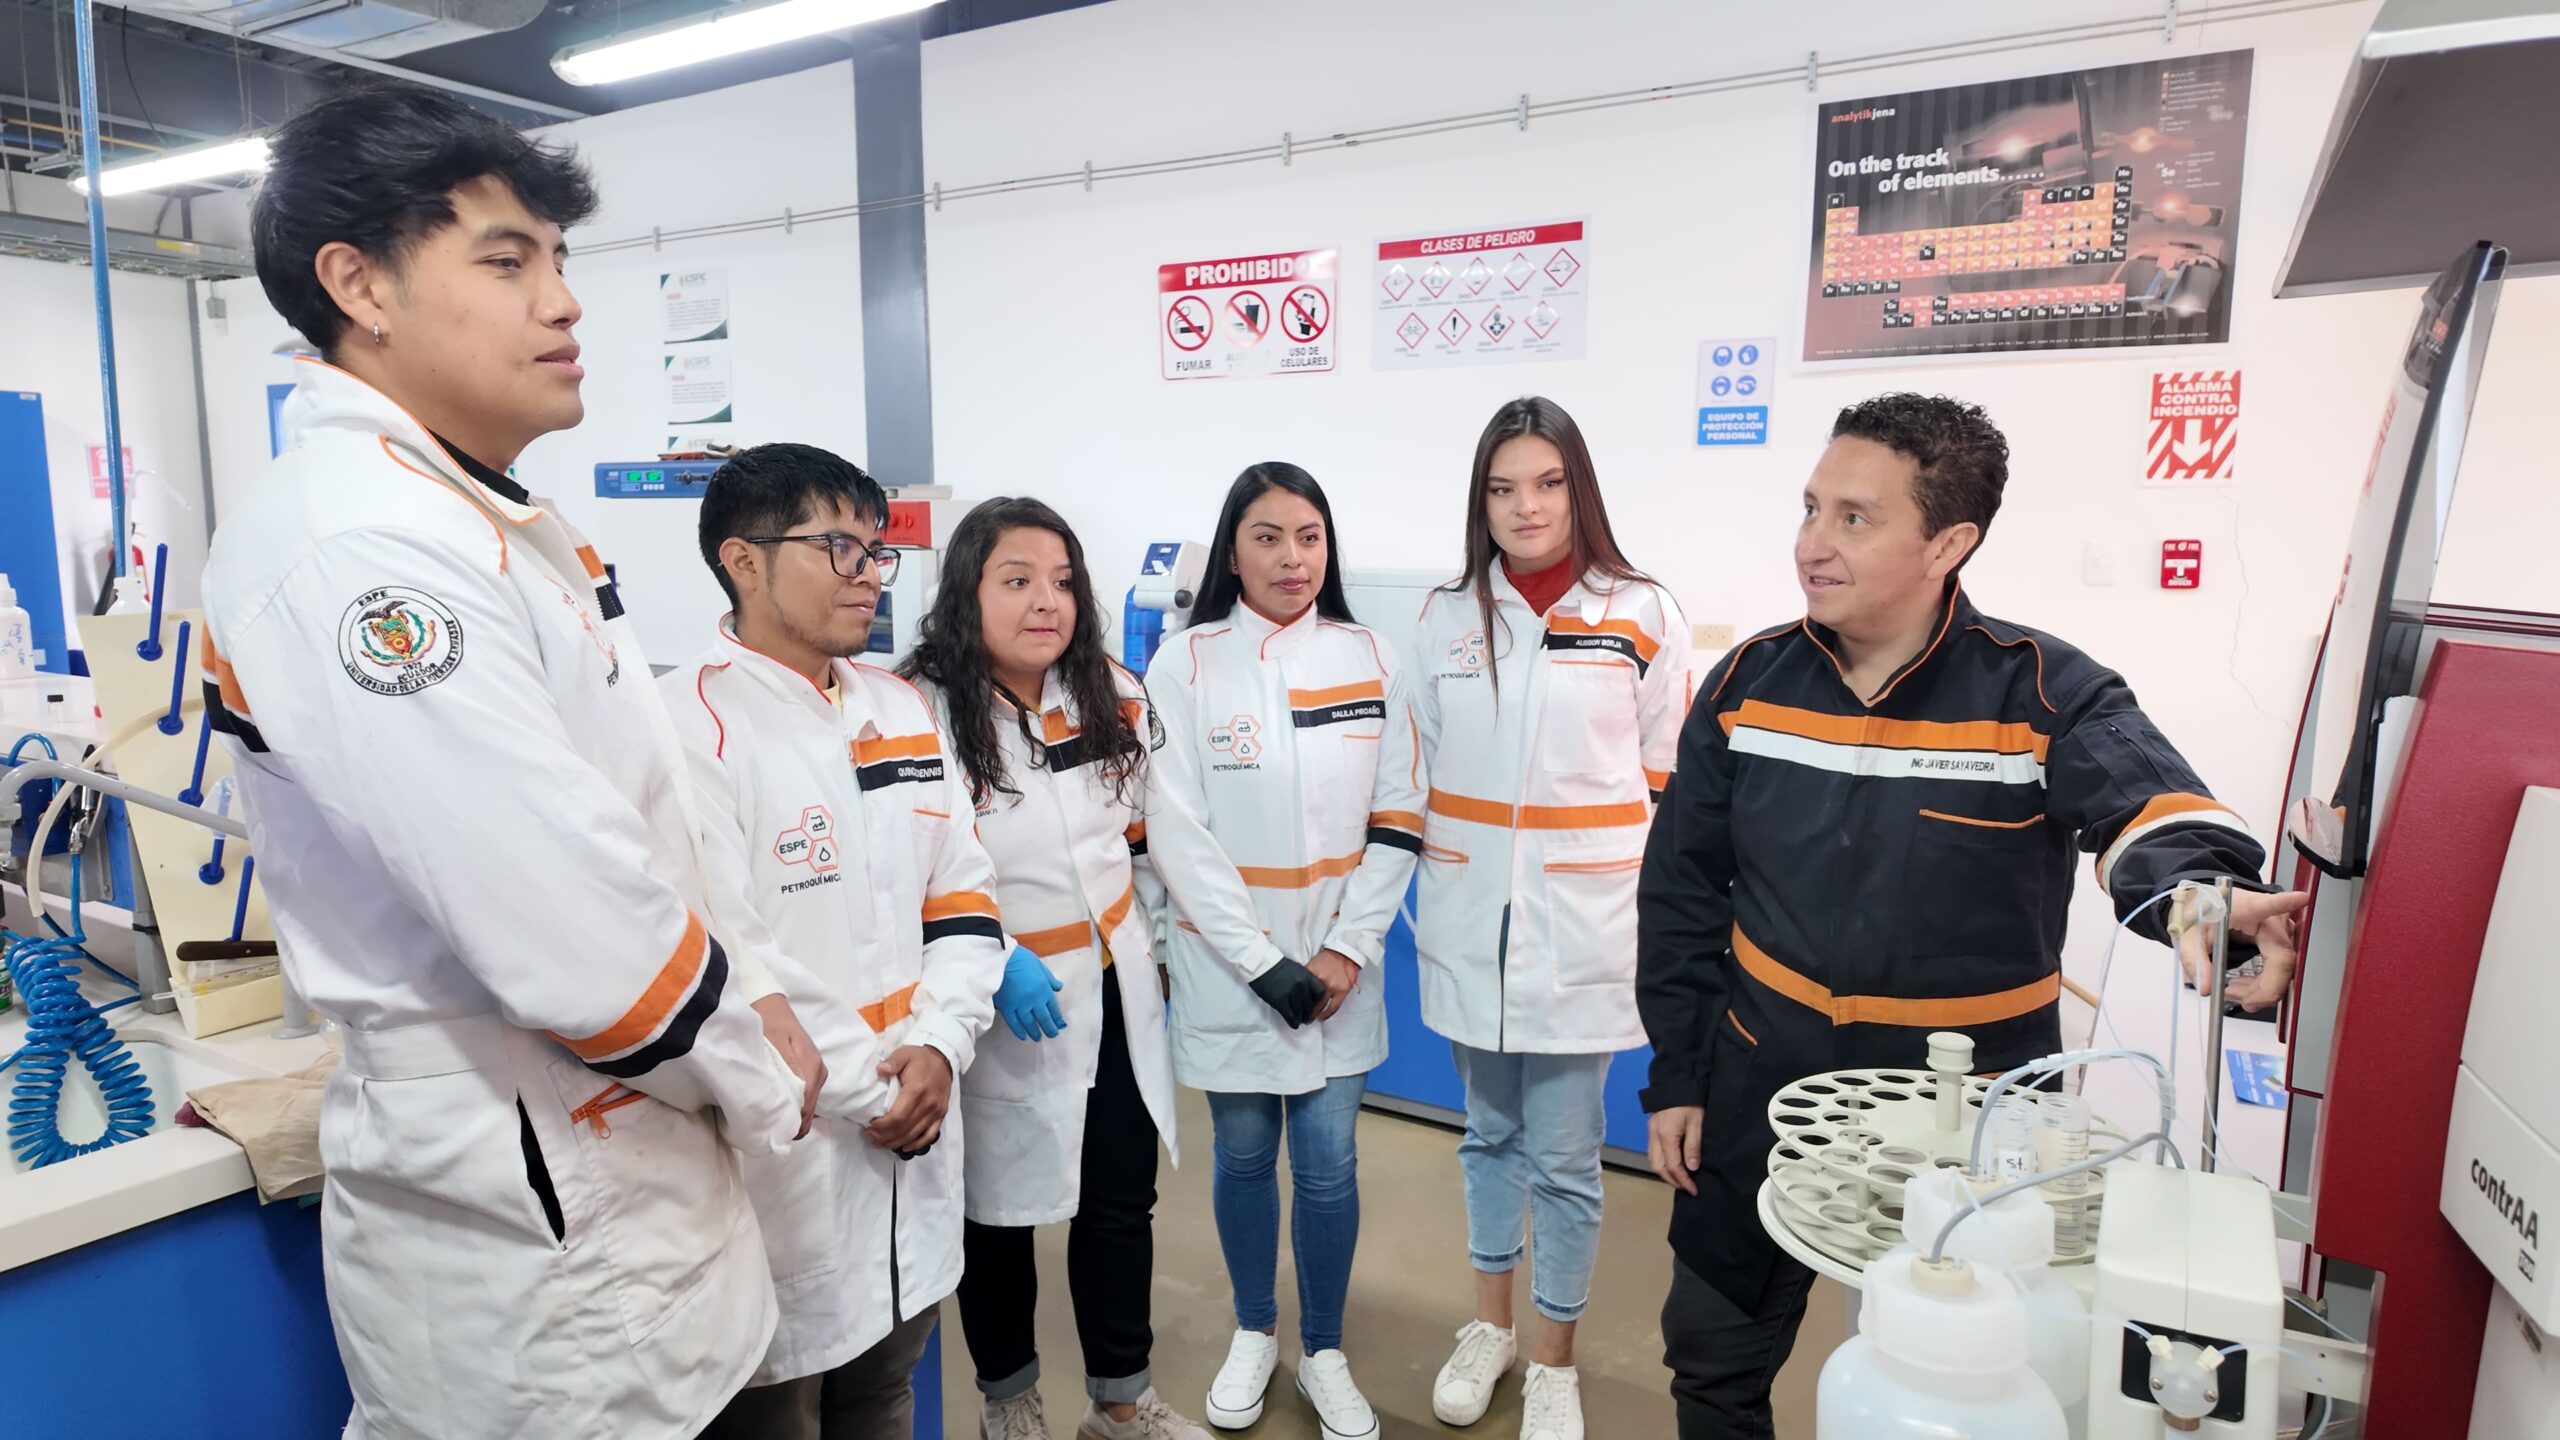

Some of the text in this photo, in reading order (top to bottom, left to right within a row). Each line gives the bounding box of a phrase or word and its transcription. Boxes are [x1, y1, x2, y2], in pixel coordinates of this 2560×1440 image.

[1831, 107, 1895, 123] analytikjena
[1828, 147, 1950, 178] On the track
[1878, 173, 1900, 193] of
[1420, 229, 1536, 253] CLASES DE PELIGRO
[1288, 346, 1320, 357] USO DE
[1176, 360, 1212, 372] FUMAR
[1280, 356, 1328, 368] CELULARES
[2160, 381, 2233, 394] ALARMA
[2160, 392, 2232, 405] CONTRA
[1707, 412, 1759, 422] EQUIPO DE
[2153, 404, 2237, 417] INCENDIO
[1702, 421, 1763, 430] PROTECCIÓN
[1707, 431, 1758, 440] PERSONAL
[358, 590, 388, 607] ESPE
[1601, 639, 1622, 649] BORJA
[346, 661, 397, 693] UNIVERSIDAD
[399, 684, 409, 693] DE
[397, 662, 438, 684] ECUADOR
[1331, 705, 1380, 719] DALILA PROAÑO
[1211, 735, 1231, 743] ESPE
[1911, 758, 1995, 771] ING JAVIER SAYAVEDRA
[779, 839, 808, 854] ESPE
[2471, 1158, 2538, 1250] contrAA
